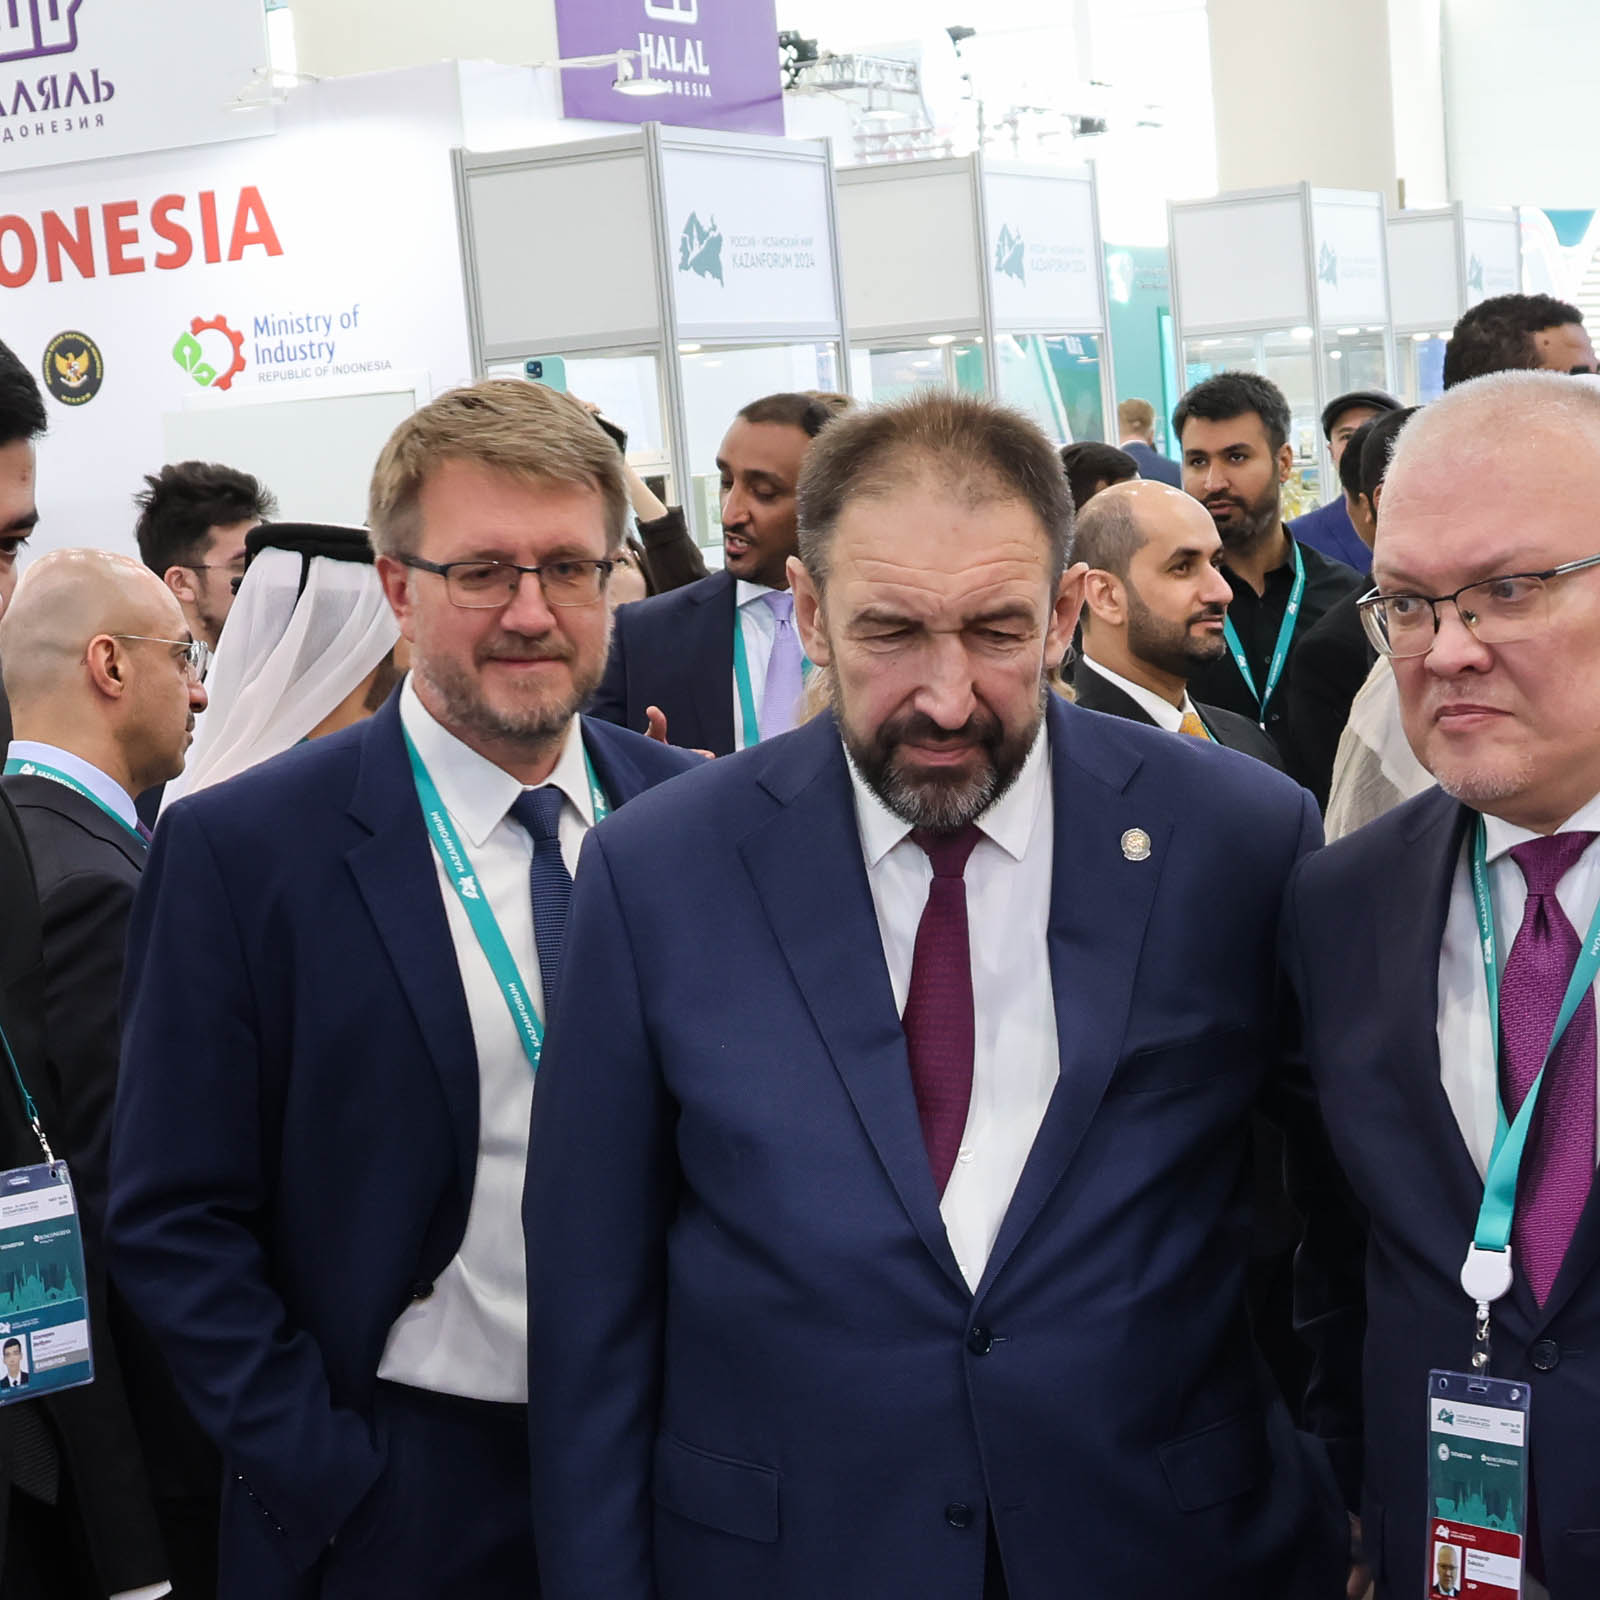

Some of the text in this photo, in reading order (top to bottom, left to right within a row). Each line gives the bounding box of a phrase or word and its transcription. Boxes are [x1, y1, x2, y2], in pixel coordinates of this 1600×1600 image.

[639, 32, 710, 76] HALAL
[254, 303, 360, 338] Ministry of
[255, 339, 335, 365] Industry
[258, 360, 392, 383] REPUBLIC OF INDONESIA
[430, 810, 465, 874] KAZANFORUM
[508, 981, 542, 1049] KAZANFORUM
